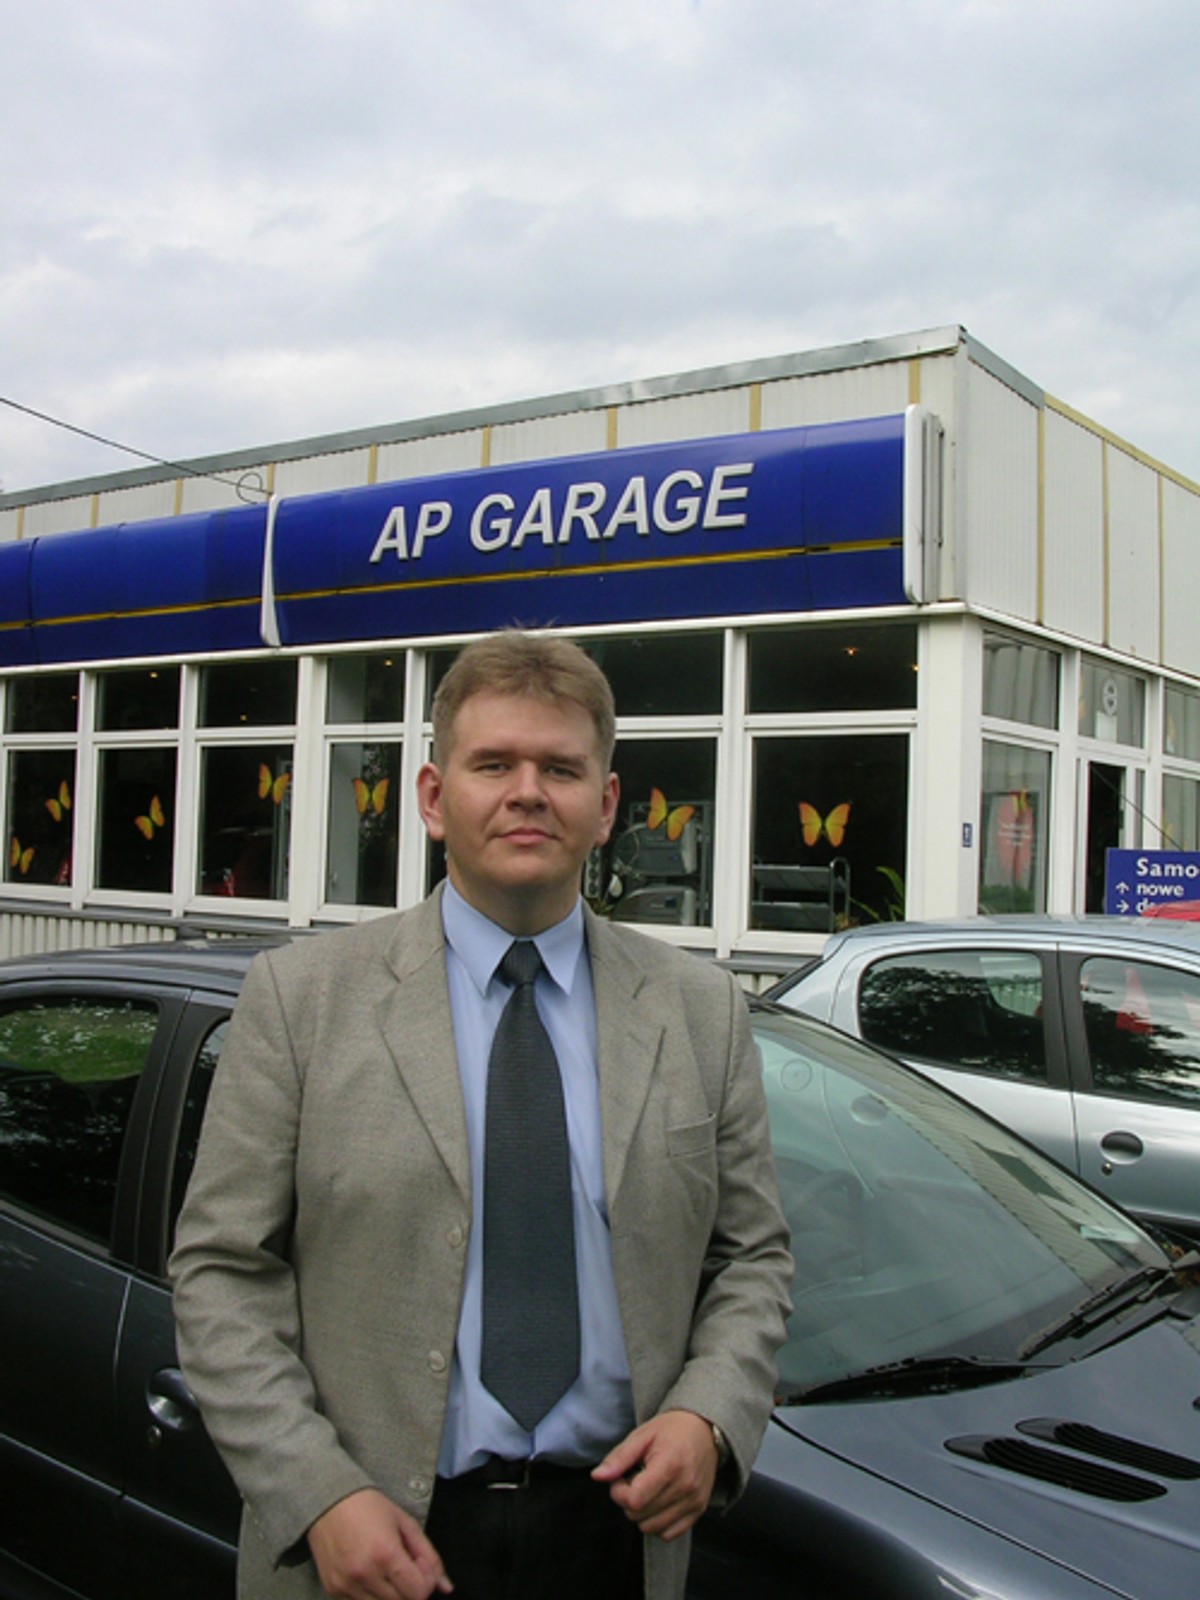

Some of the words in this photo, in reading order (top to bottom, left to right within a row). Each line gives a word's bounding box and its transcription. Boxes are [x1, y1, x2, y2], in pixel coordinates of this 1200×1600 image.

[369, 501, 453, 563] AP
[470, 462, 755, 551] GARAGE
[1137, 883, 1185, 898] nowe
